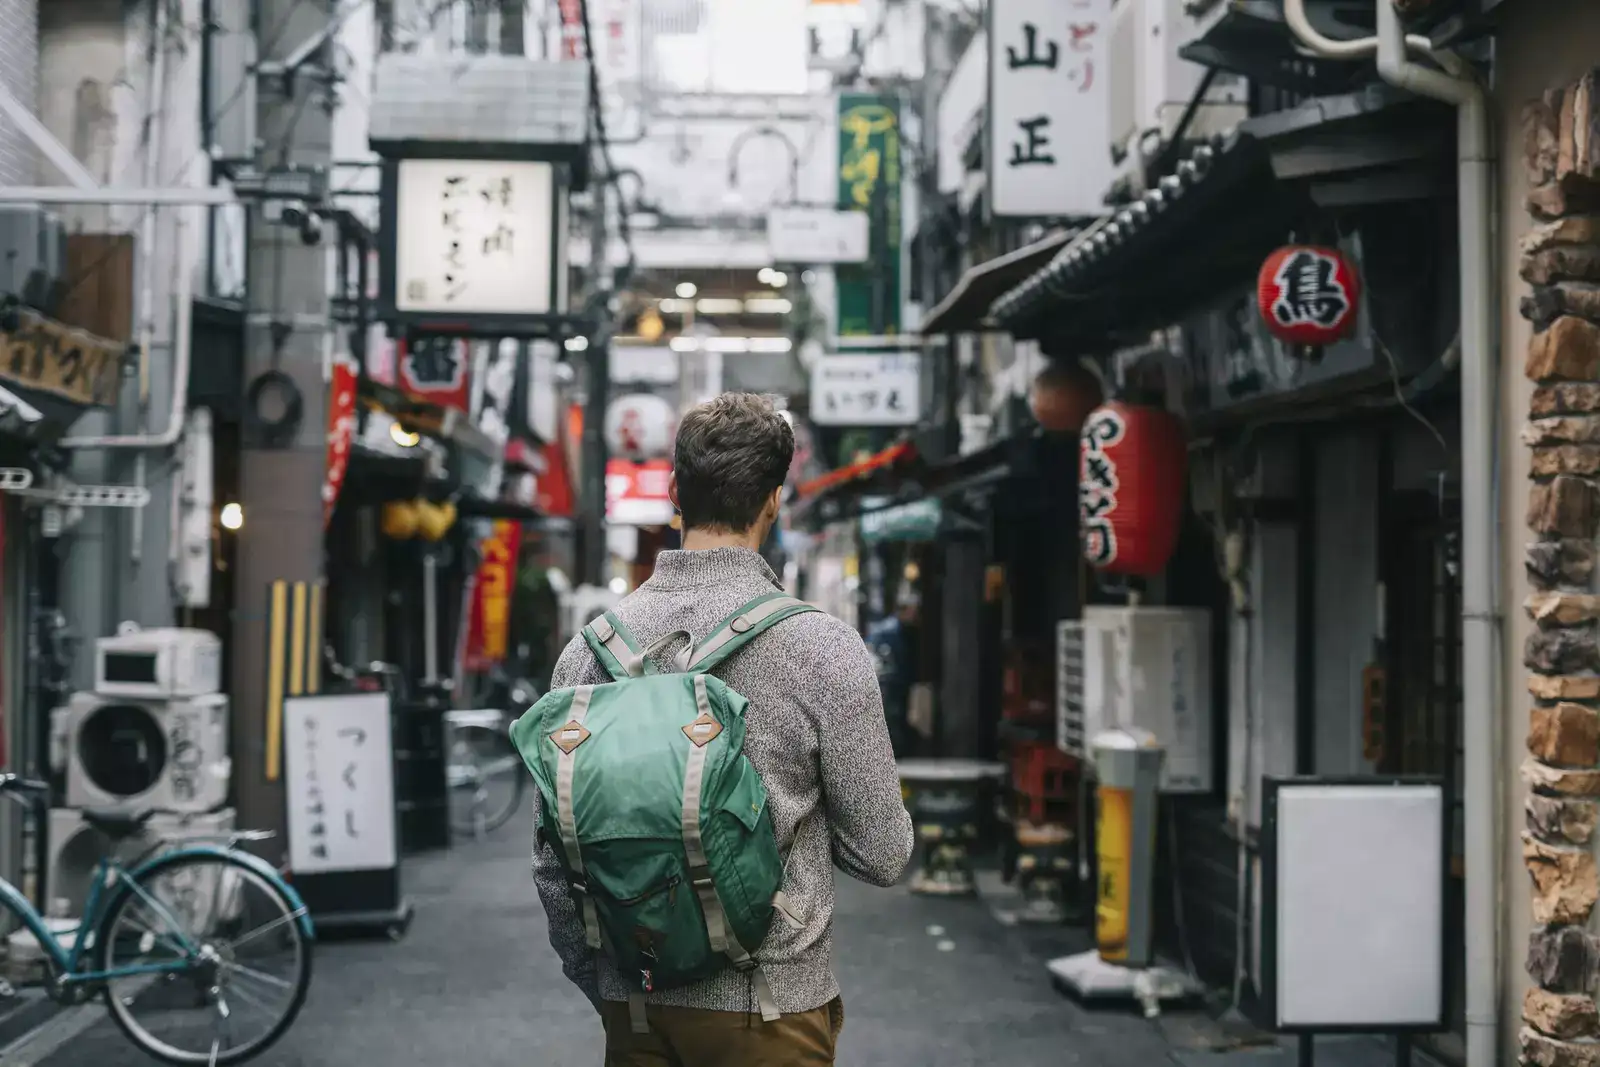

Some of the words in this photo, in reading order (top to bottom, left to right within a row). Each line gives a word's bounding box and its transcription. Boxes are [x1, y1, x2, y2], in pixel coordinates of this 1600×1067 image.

[1006, 21, 1059, 168] 山正
[1066, 0, 1096, 93] とり
[1275, 250, 1348, 327] 鳥
[1079, 410, 1126, 567] やきとり
[337, 725, 367, 840] つくし
